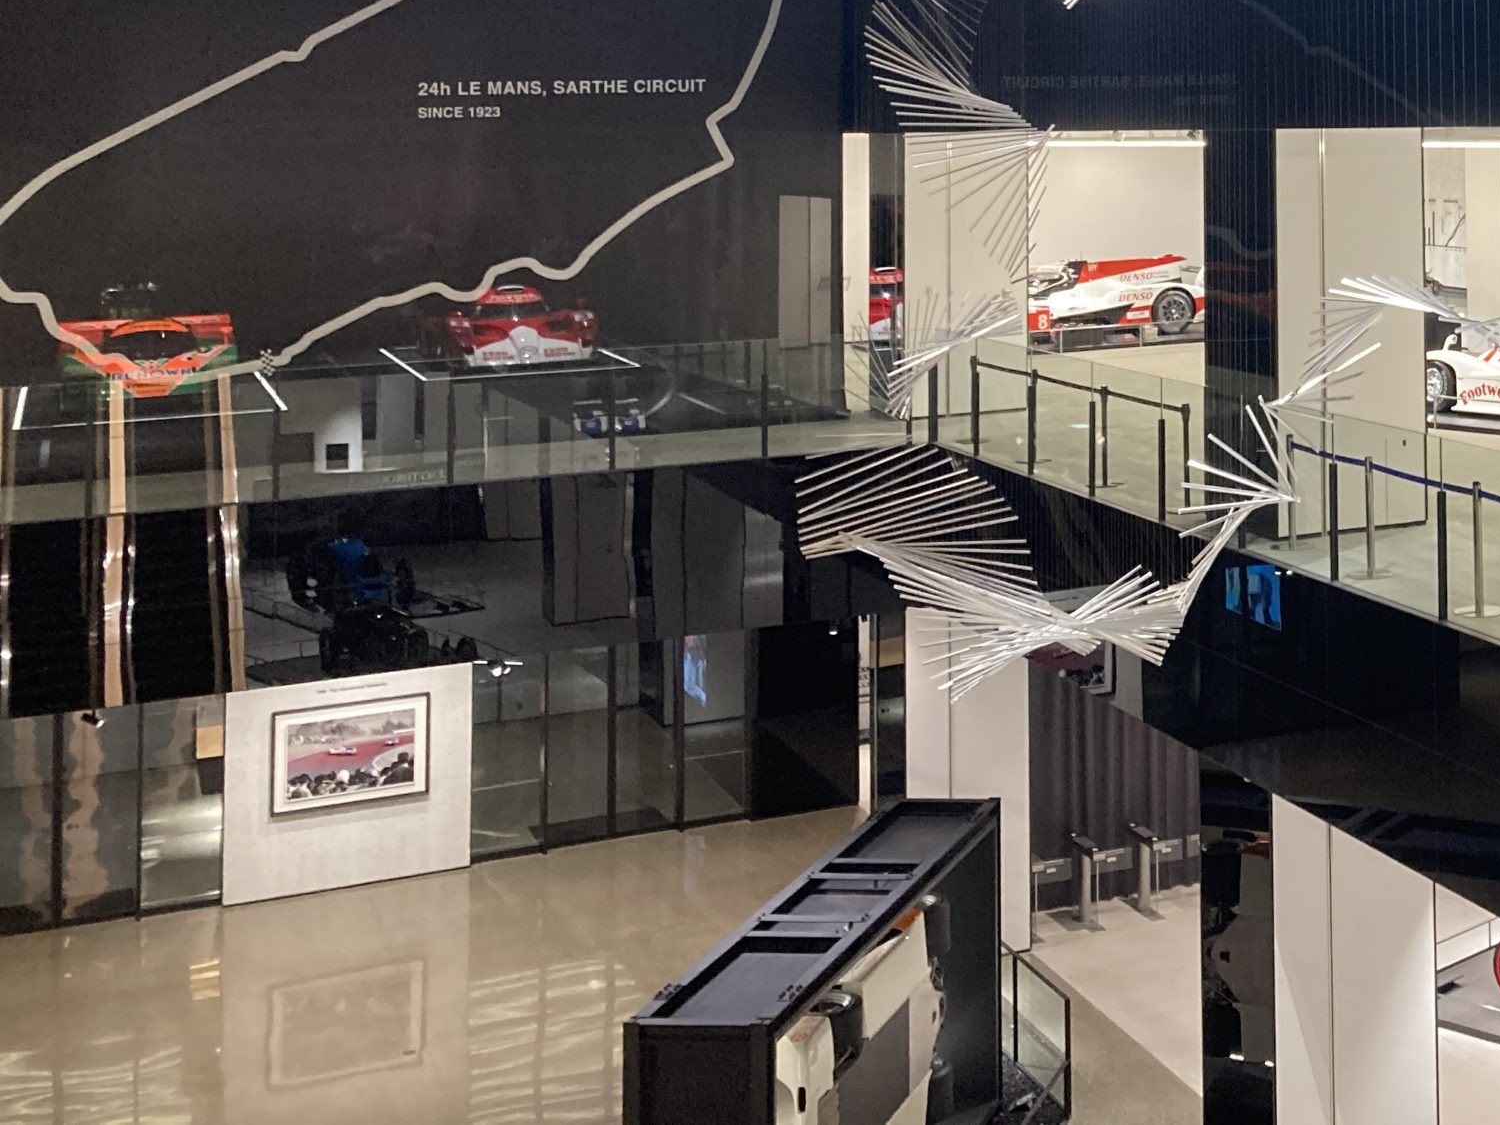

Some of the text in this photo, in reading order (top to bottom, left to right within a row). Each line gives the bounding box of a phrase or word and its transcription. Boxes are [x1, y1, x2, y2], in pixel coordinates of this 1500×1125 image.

[418, 79, 706, 96] 24h LE MANS, SARTHE CIRCUIT
[418, 106, 501, 118] SINCE 1923
[1120, 273, 1153, 282] DENSO
[1119, 291, 1153, 302] DENSO
[1038, 314, 1048, 330] 8
